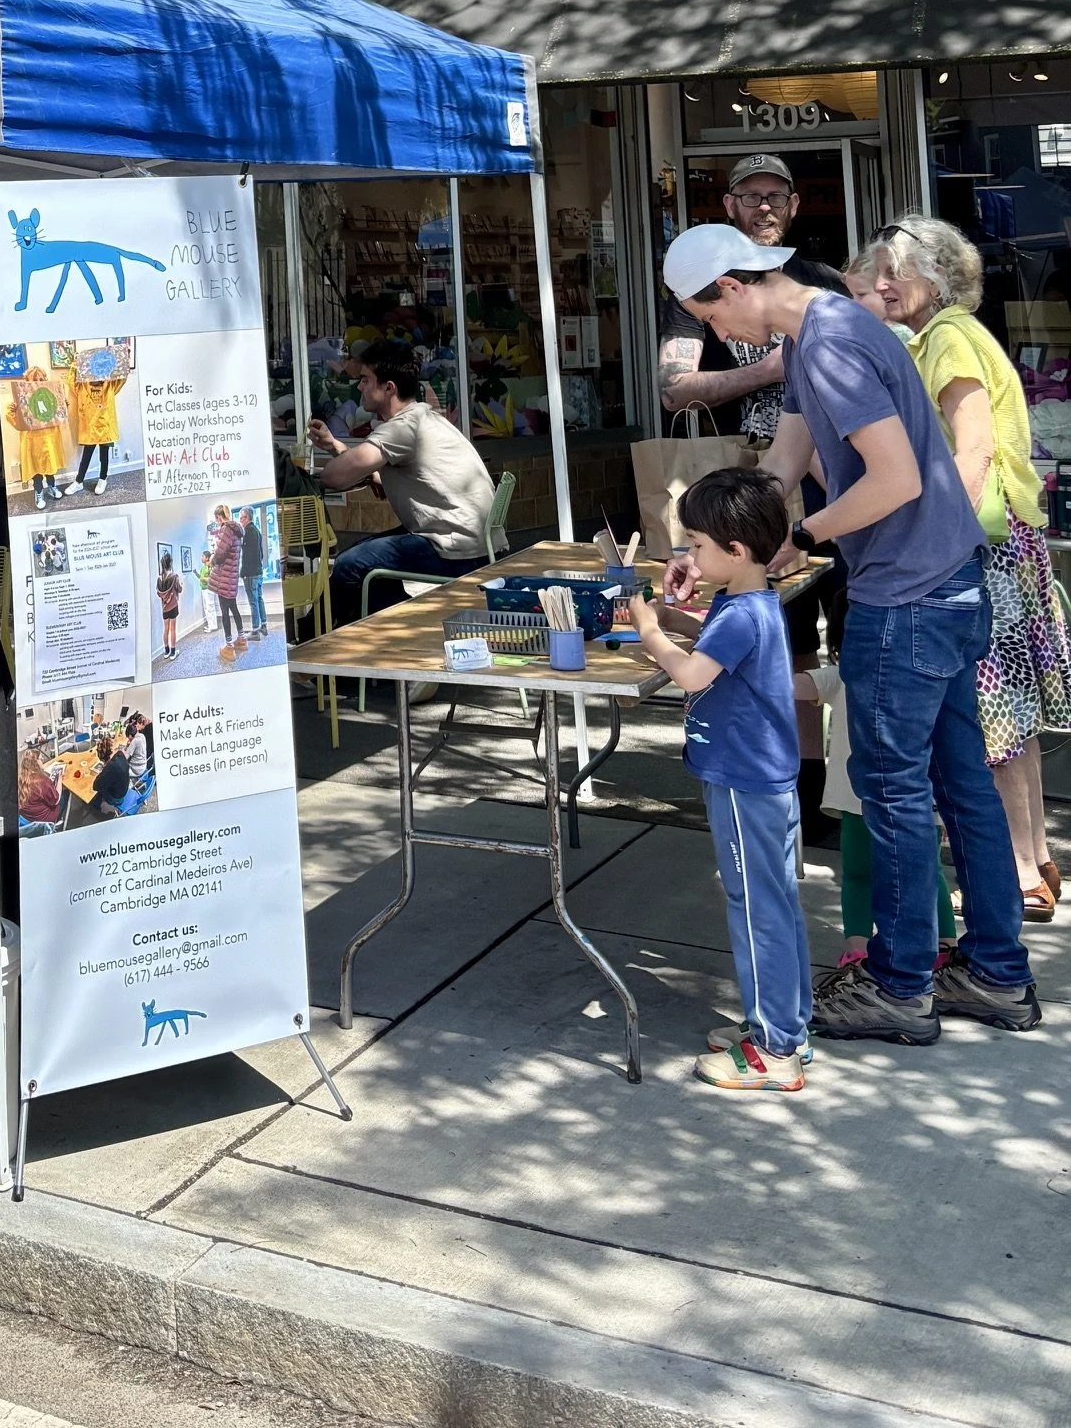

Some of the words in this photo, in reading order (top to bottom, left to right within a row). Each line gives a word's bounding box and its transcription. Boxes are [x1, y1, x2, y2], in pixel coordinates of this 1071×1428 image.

[735, 101, 820, 133] 1309
[750, 155, 765, 168] B
[186, 210, 237, 234] BLUE
[170, 243, 239, 267] MOUSE
[165, 276, 242, 300] GALLERY
[145, 385, 164, 396] For
[167, 382, 193, 395] Kids:
[146, 402, 163, 414] Art
[165, 400, 200, 412] Classes
[202, 397, 230, 412] (ages
[232, 394, 258, 407] 3-12)
[148, 417, 186, 432] Holiday
[188, 414, 244, 427] Workshops
[148, 436, 190, 449] Vacation
[192, 432, 242, 446] Programs
[146, 450, 177, 467] NEW:
[179, 447, 197, 464] Art
[202, 444, 230, 462] Club
[165, 468, 208, 484] Afternoon
[211, 462, 250, 482] Program
[161, 482, 212, 496] 2026-2027
[158, 712, 179, 724] For
[183, 705, 224, 721] Adults:
[160, 726, 192, 742] Make
[194, 725, 212, 738] Art
[214, 722, 224, 734] &
[226, 714, 264, 732] Friends
[161, 744, 208, 760] German
[210, 736, 262, 753] Language
[169, 762, 212, 777] Classes
[213, 758, 226, 772] (in
[229, 750, 268, 770] person)
[79, 824, 241, 864] www.bluemousegallery.com
[98, 863, 119, 878] 722
[122, 854, 187, 874] Cambridge
[190, 846, 222, 862] Street
[69, 884, 106, 906] (corner
[110, 878, 123, 894] of
[125, 872, 174, 892] Cardinal
[176, 863, 228, 882] Medeiros
[230, 856, 254, 872] Ave)
[100, 892, 167, 914] Cambridge
[169, 889, 189, 902] MA
[191, 880, 224, 898] 02141
[132, 926, 179, 946] Contact
[182, 924, 198, 936] us:
[79, 931, 248, 975] bluemousegallery@gmail.com
[124, 969, 151, 988] (617)
[153, 964, 174, 979] 444
[183, 956, 210, 973] 9566
